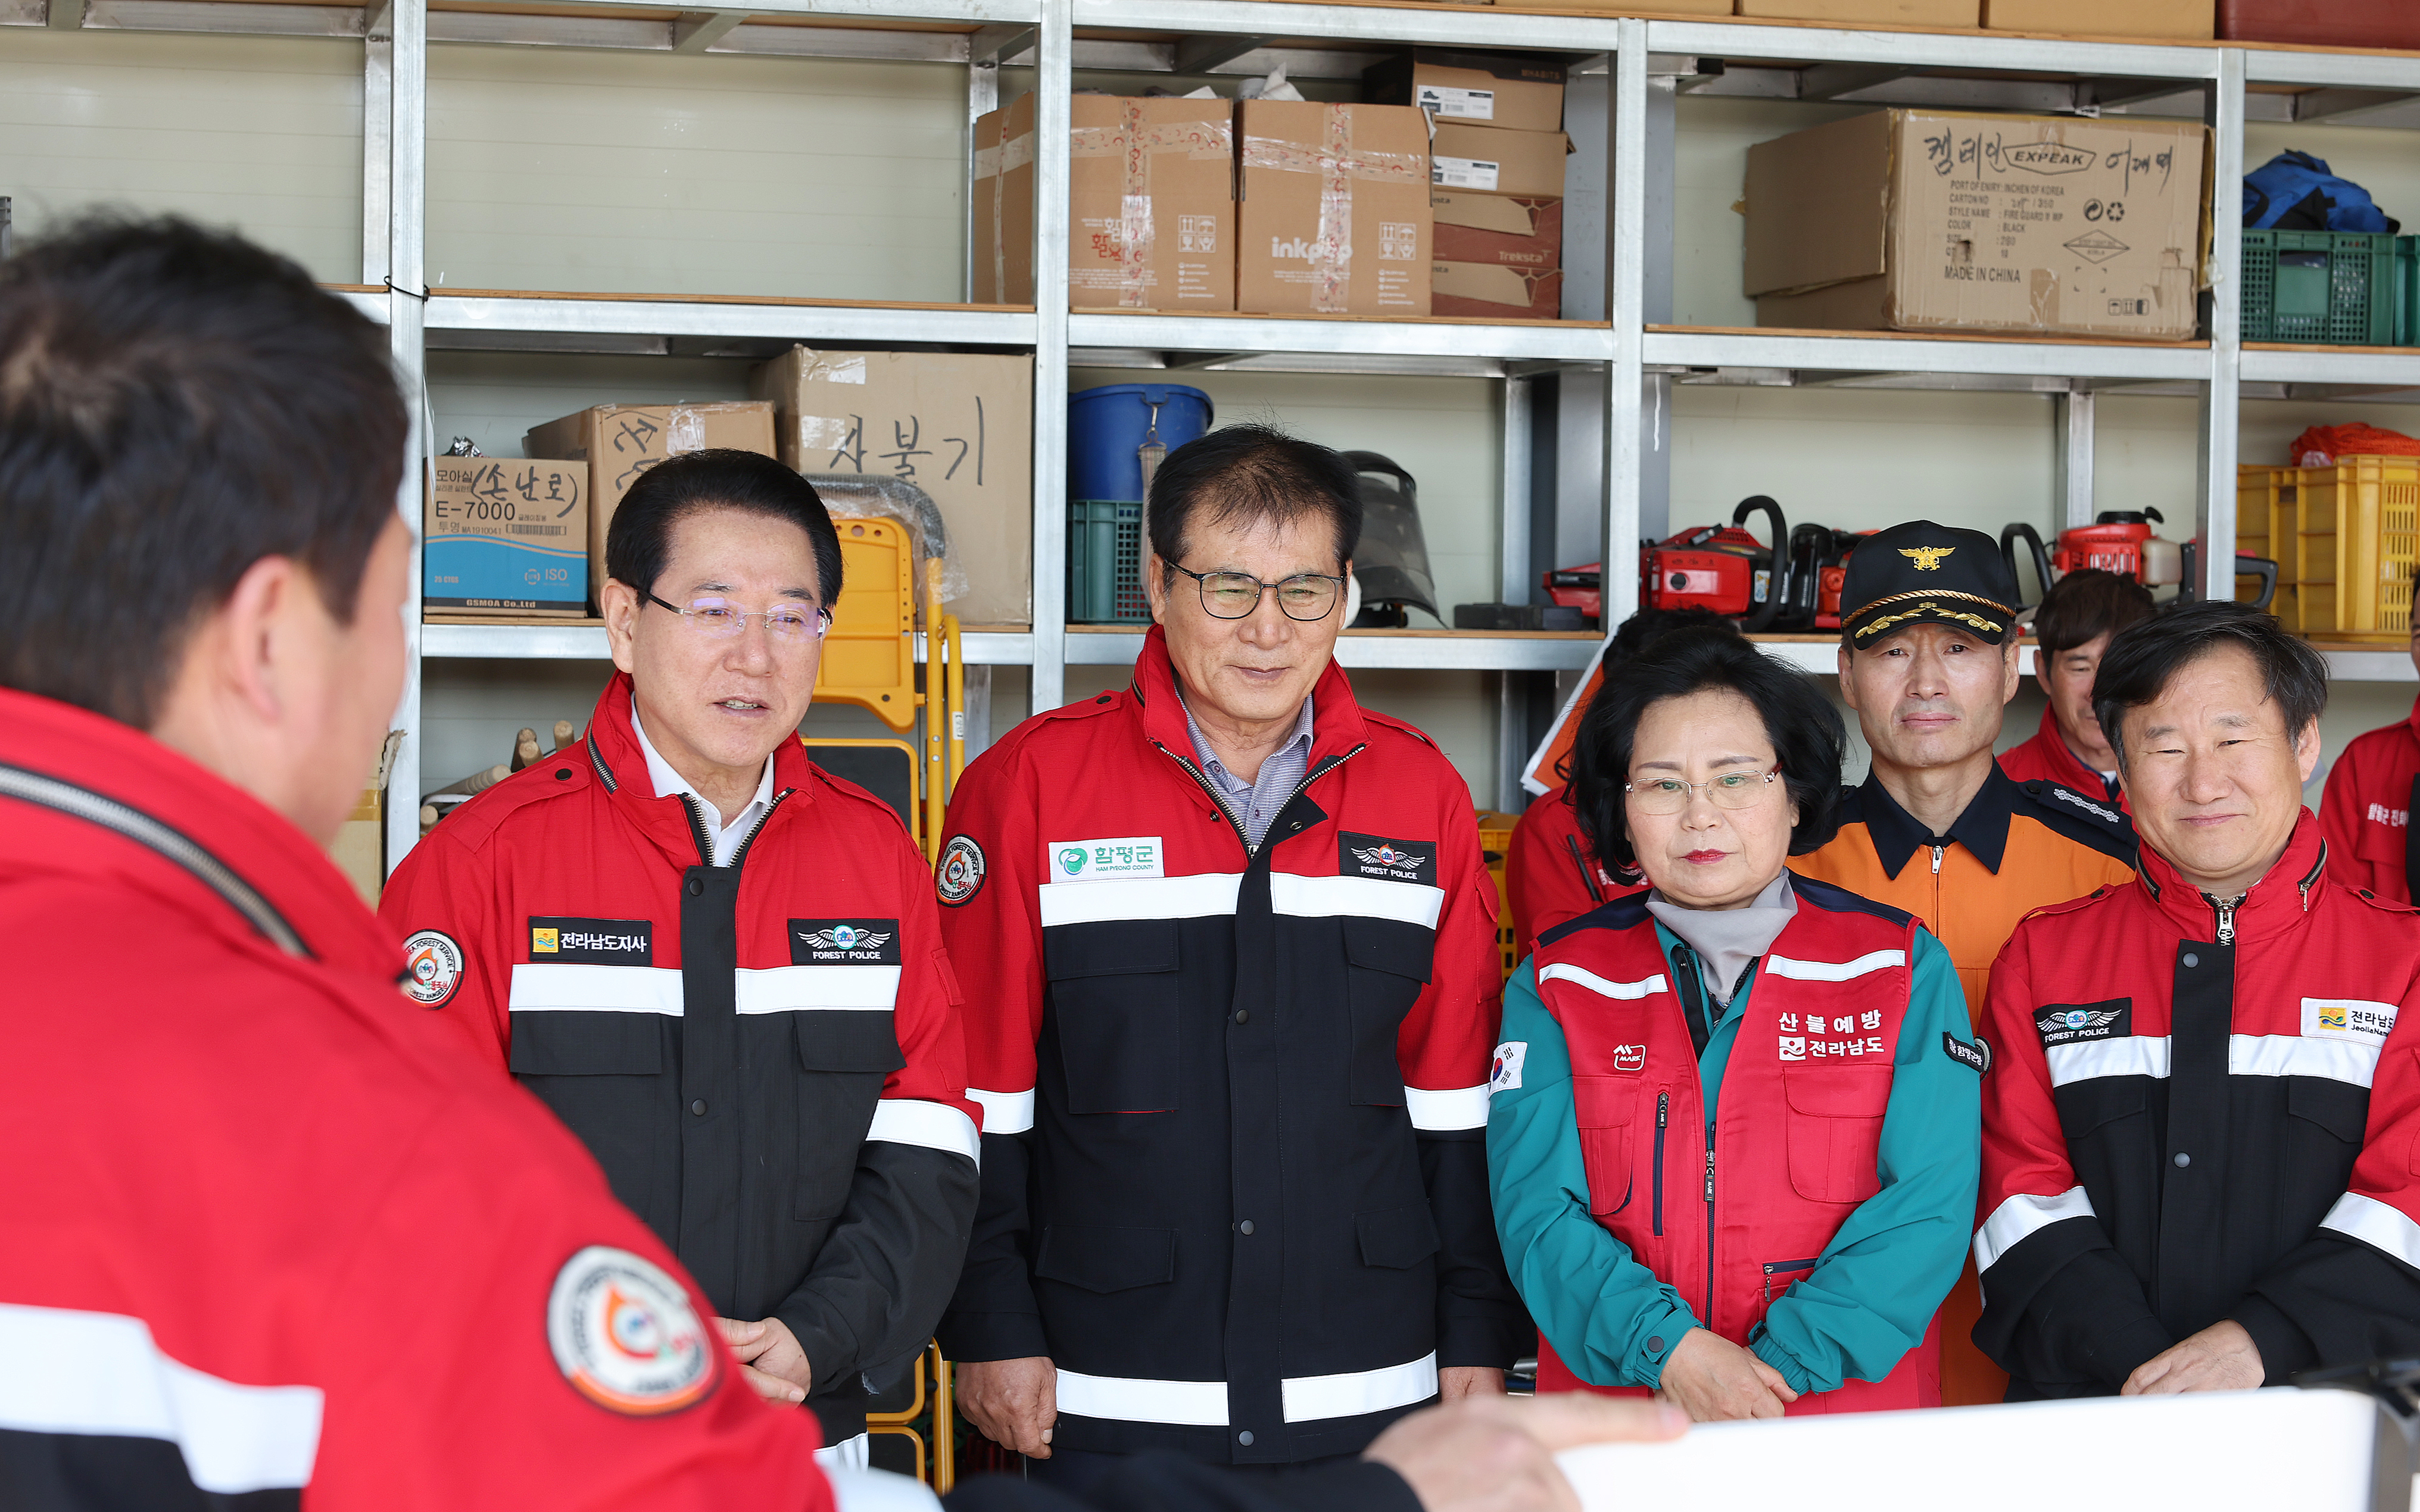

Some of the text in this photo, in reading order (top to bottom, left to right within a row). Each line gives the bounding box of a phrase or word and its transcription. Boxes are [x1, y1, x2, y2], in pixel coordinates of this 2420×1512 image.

[2014, 151, 2084, 165] EXPEAK
[2041, 185, 2065, 196] KOREA
[1949, 193, 1978, 204] CARTON
[1947, 220, 1971, 230] COLOR
[2003, 221, 2025, 233] BLACK
[1498, 250, 1543, 263] Treksta
[1944, 266, 2021, 283] MADE IN CHINA
[436, 470, 472, 483] 모아실
[436, 501, 515, 520] E-7000
[545, 568, 568, 581] ISO
[466, 599, 501, 607] GSMOA
[1094, 846, 1153, 864] 함평군
[1361, 866, 1418, 880] FOREST POLICE
[560, 932, 647, 953] 전라남도지사
[438, 944, 454, 968] SERVICE
[812, 951, 881, 960] FOREST POLICE
[2045, 1027, 2110, 1043] FOREST POLICE
[1808, 1036, 1885, 1058] 전라남도
